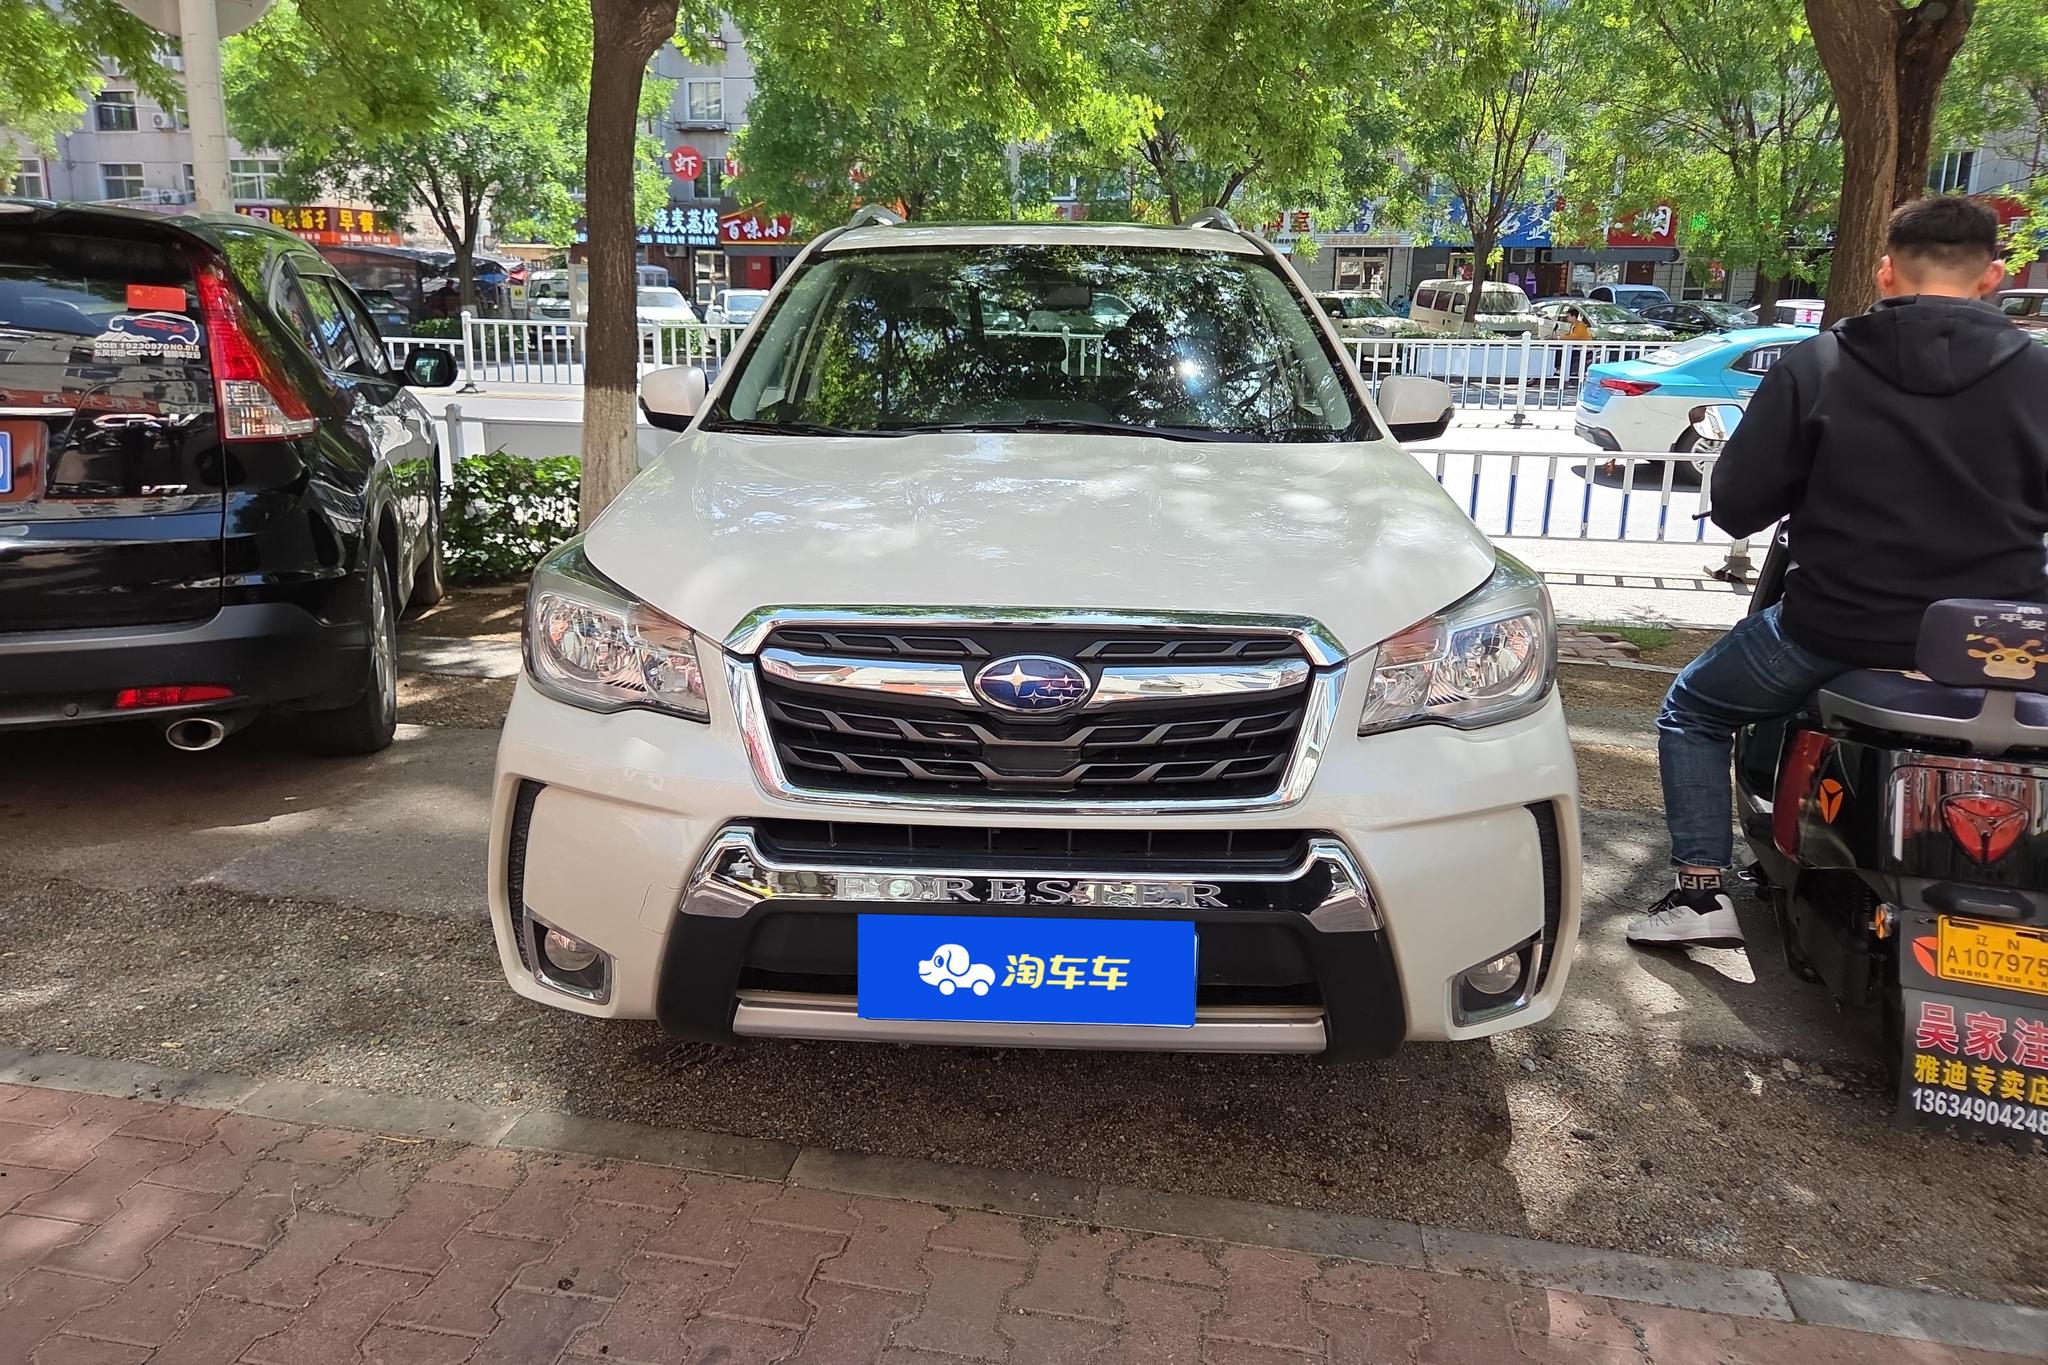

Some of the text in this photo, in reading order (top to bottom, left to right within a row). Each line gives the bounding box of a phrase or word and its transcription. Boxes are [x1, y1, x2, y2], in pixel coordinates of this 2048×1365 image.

[673, 152, 698, 178] 虾
[832, 874, 1229, 909] FORESTER
[1914, 1053, 2048, 1106] 雅迪专卖店
[1912, 1087, 2048, 1136] 13634904248
